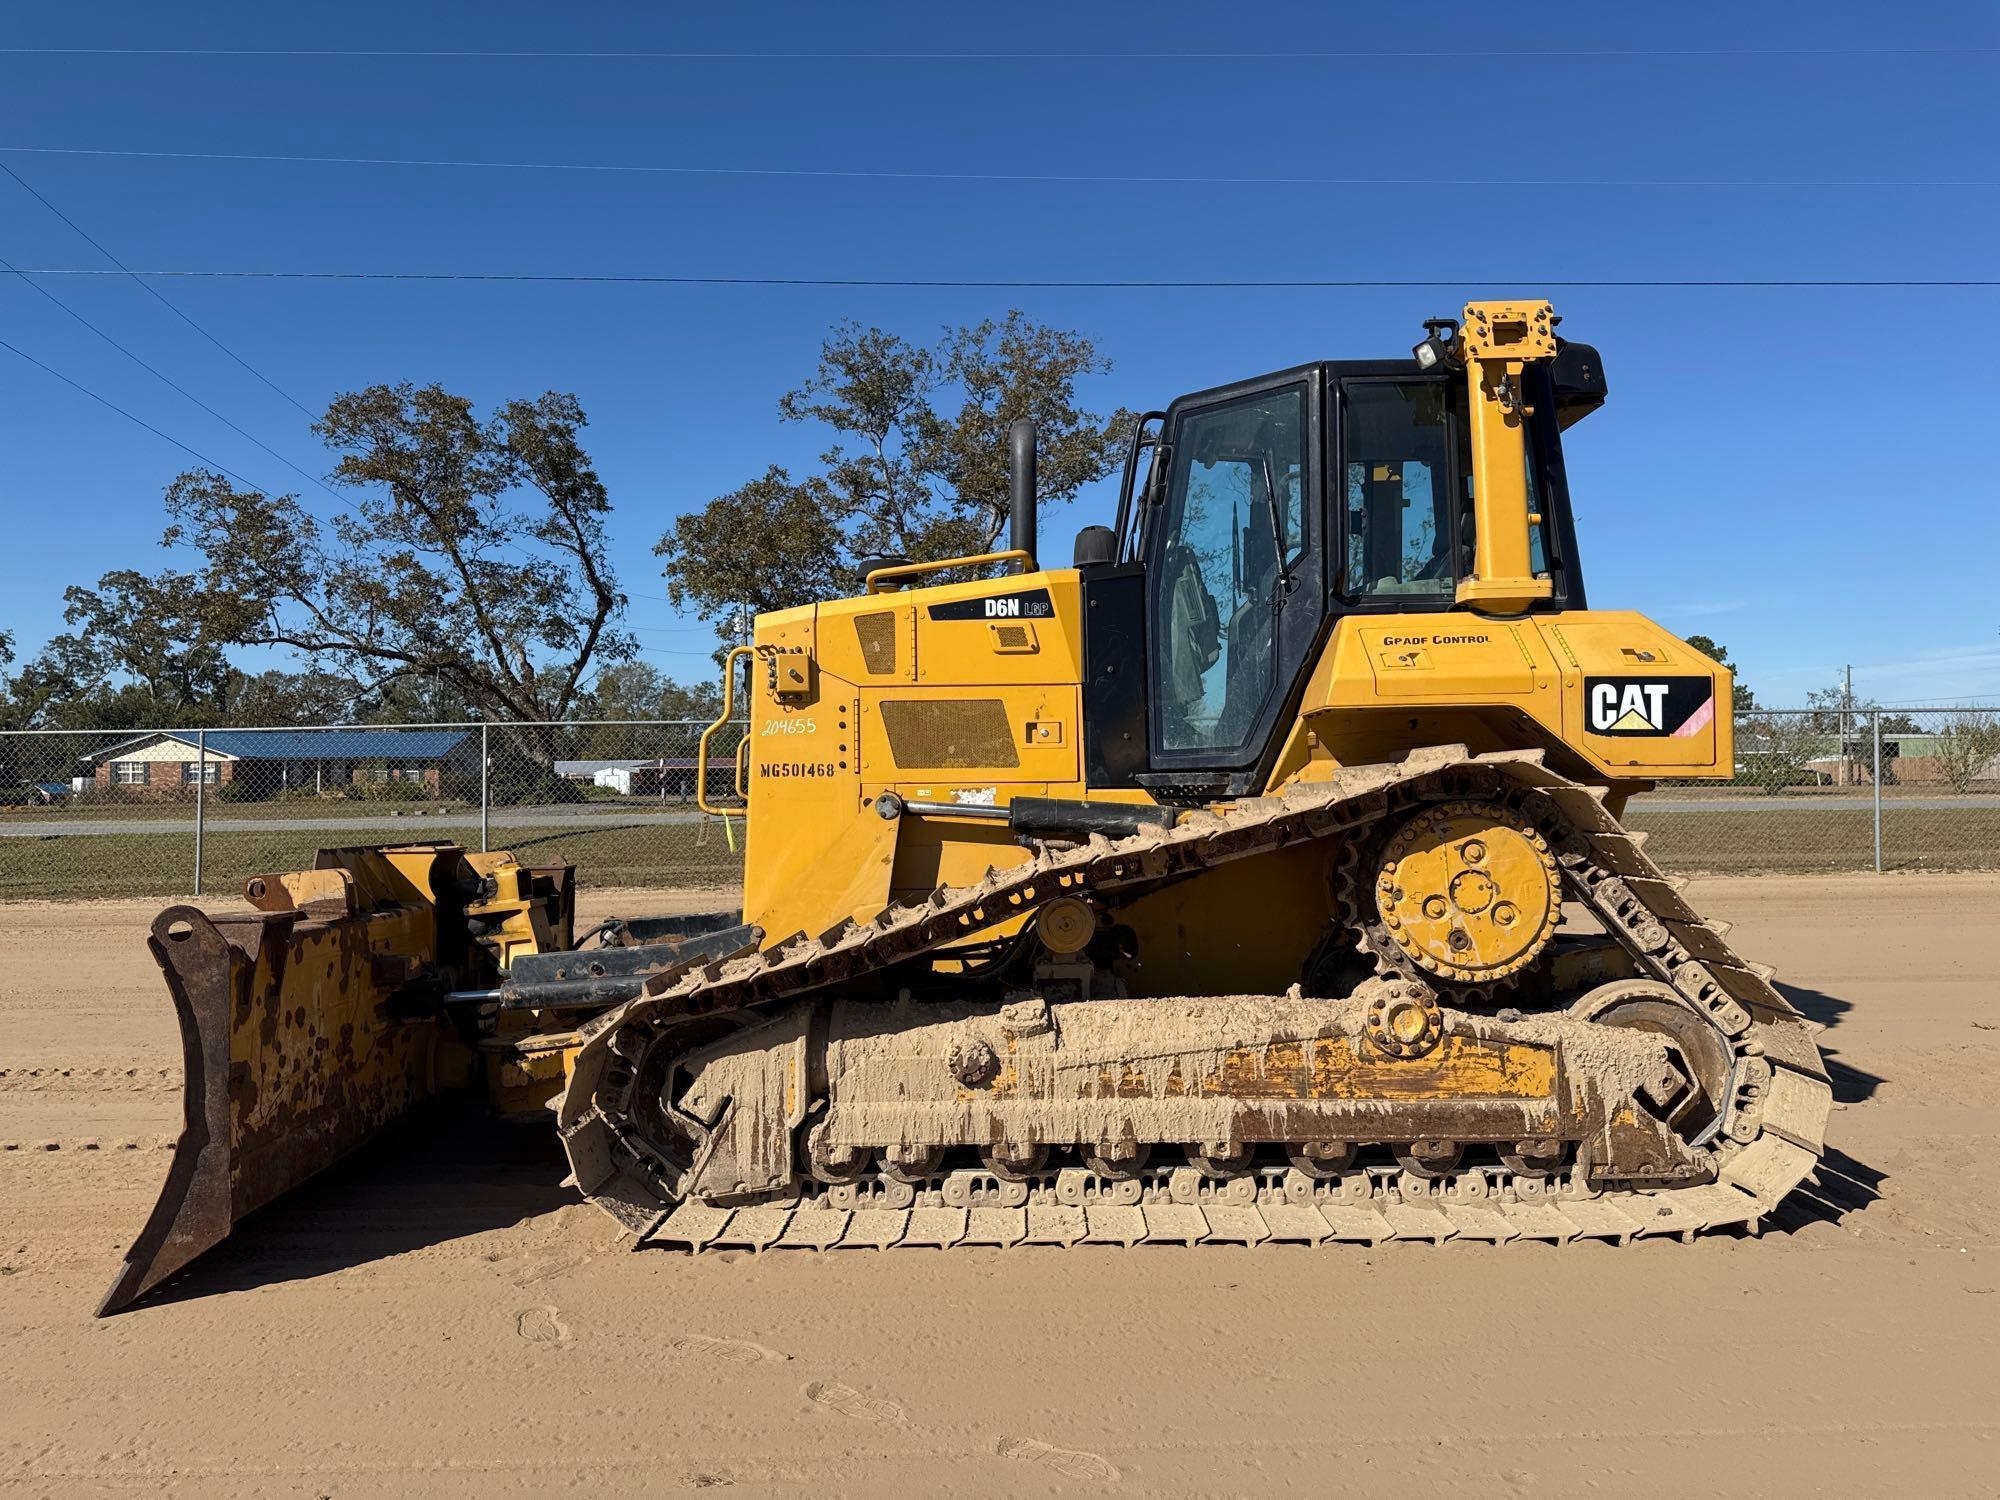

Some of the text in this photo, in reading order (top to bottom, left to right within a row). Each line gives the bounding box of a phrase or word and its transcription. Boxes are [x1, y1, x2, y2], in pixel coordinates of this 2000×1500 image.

[985, 598, 1049, 617] D6N LGP
[1591, 683, 1669, 731] CAT
[761, 717, 817, 737] 204655
[760, 763, 834, 778] MG501468
